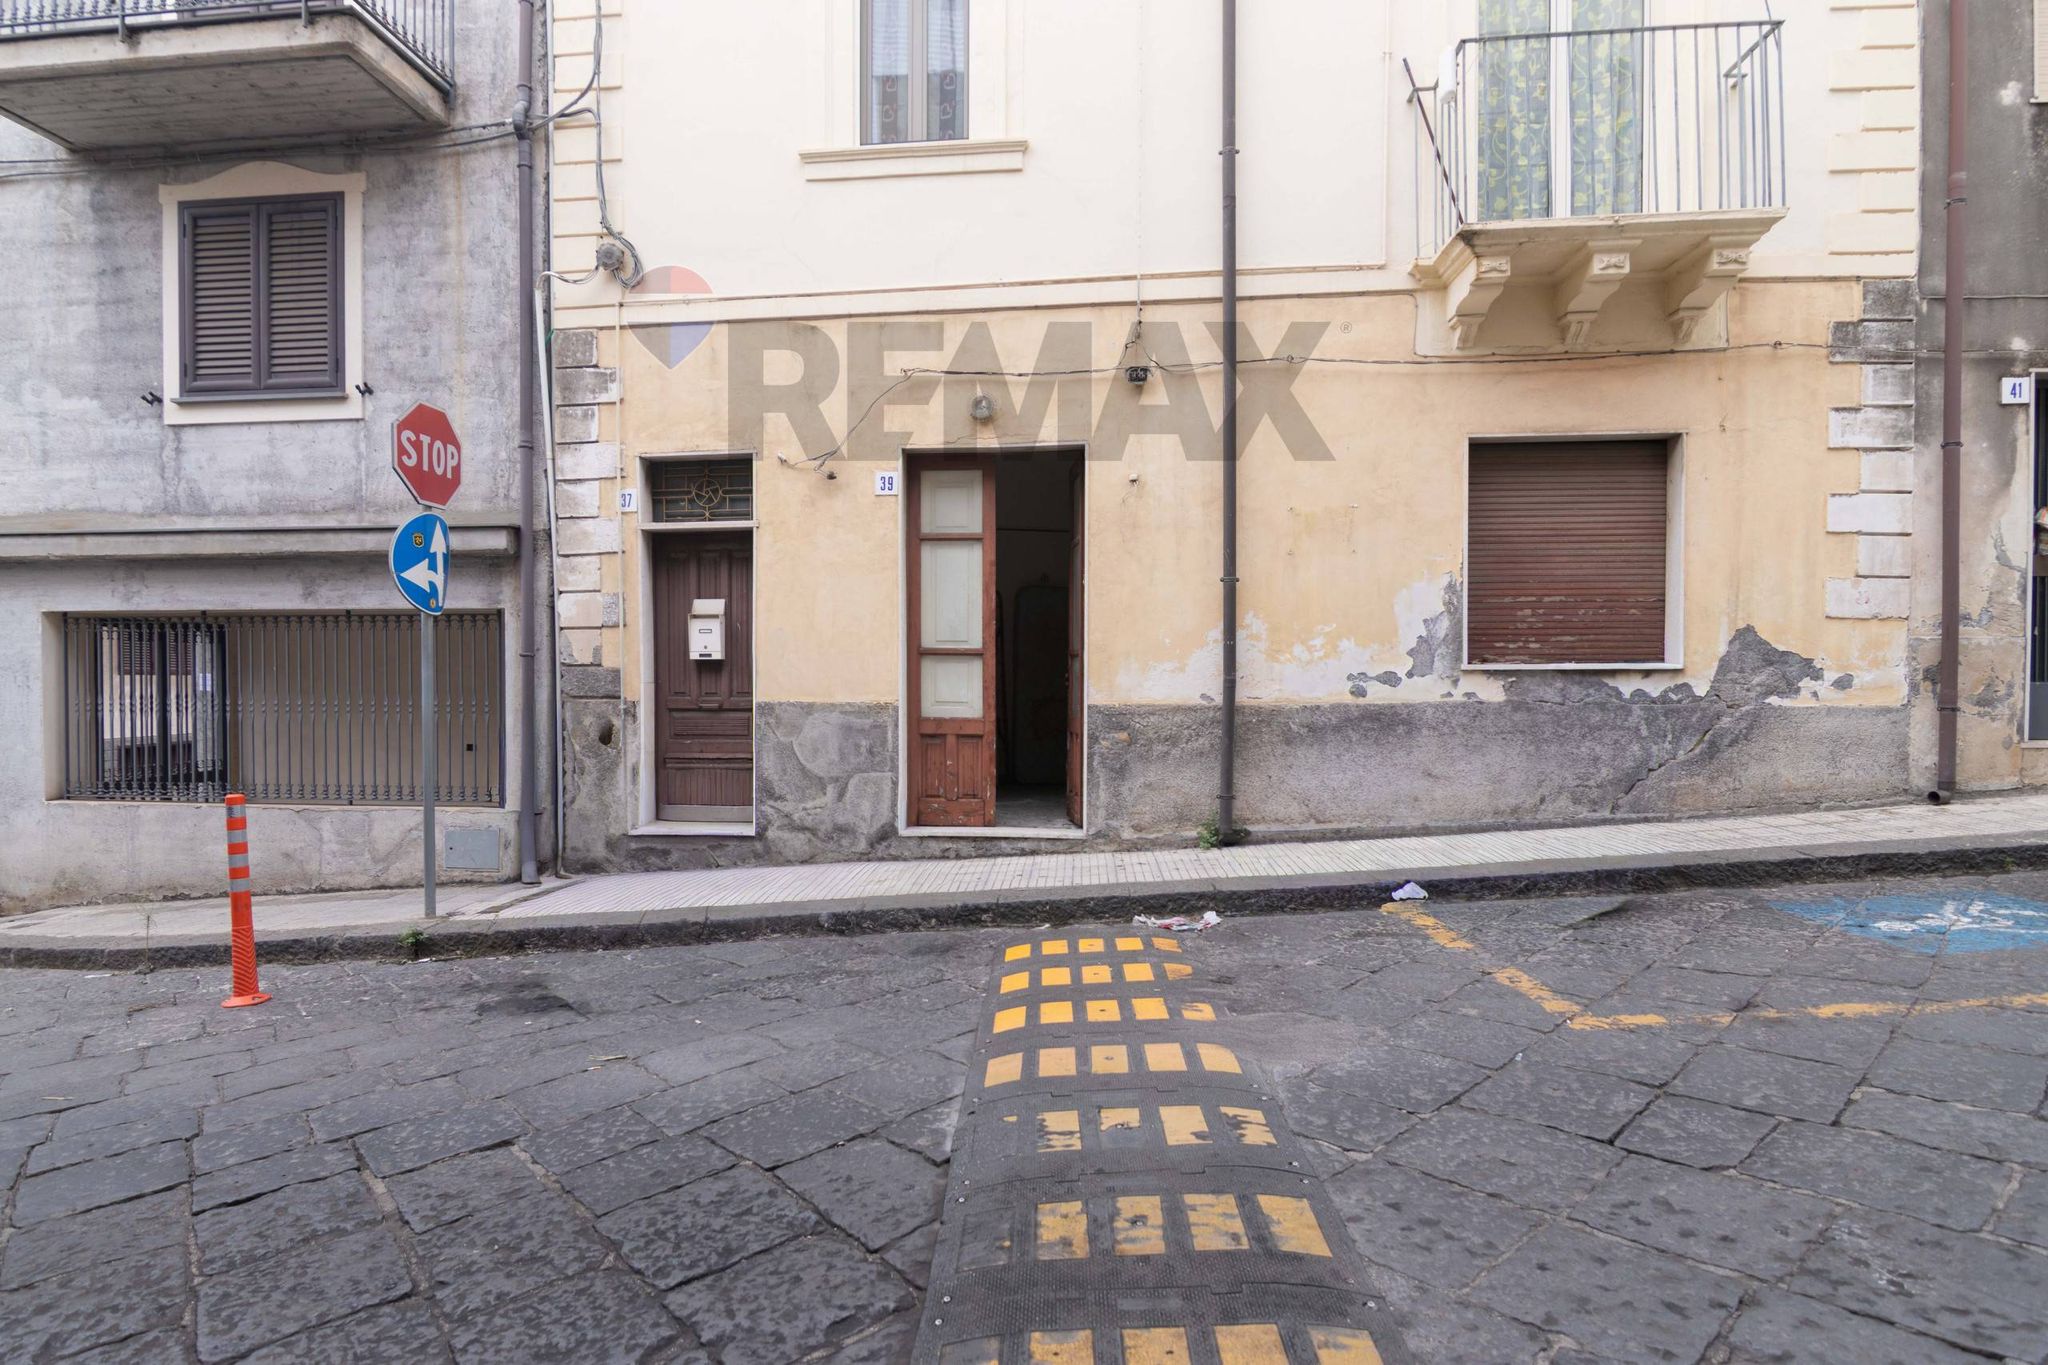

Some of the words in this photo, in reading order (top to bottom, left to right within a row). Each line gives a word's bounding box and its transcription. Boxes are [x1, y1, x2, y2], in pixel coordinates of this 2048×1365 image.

[2010, 382, 2022, 399] 41
[400, 429, 459, 479] STOP
[880, 476, 894, 491] 39
[621, 493, 632, 508] 37
